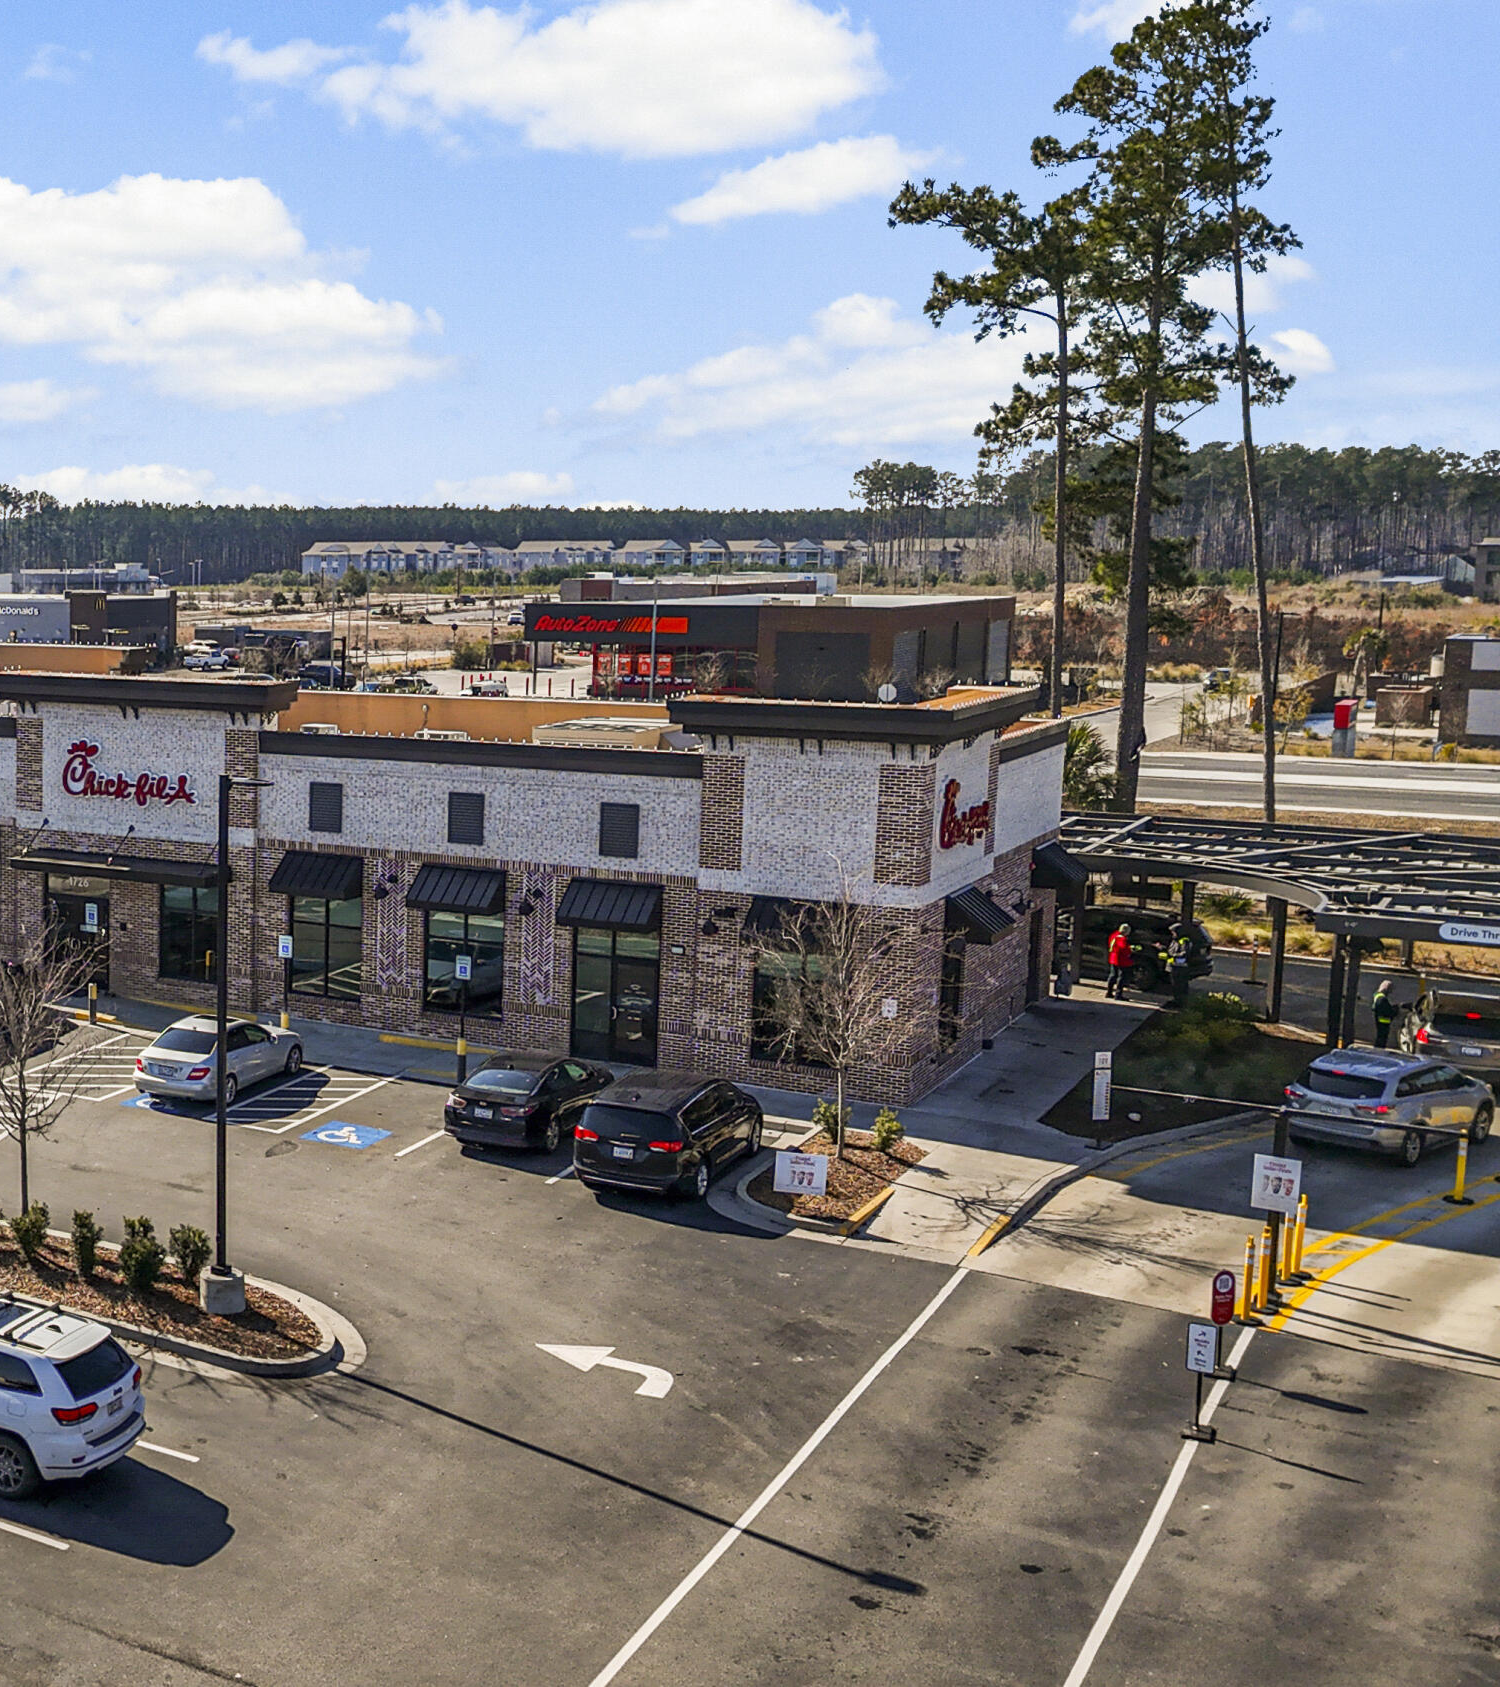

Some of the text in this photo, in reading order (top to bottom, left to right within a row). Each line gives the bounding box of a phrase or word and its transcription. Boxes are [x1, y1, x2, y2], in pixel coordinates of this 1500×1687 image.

[534, 614, 619, 632] AutoZone
[62, 752, 198, 807] Chick-fil-A
[69, 876, 90, 888] 1726
[1450, 927, 1500, 940] Drive Thr
